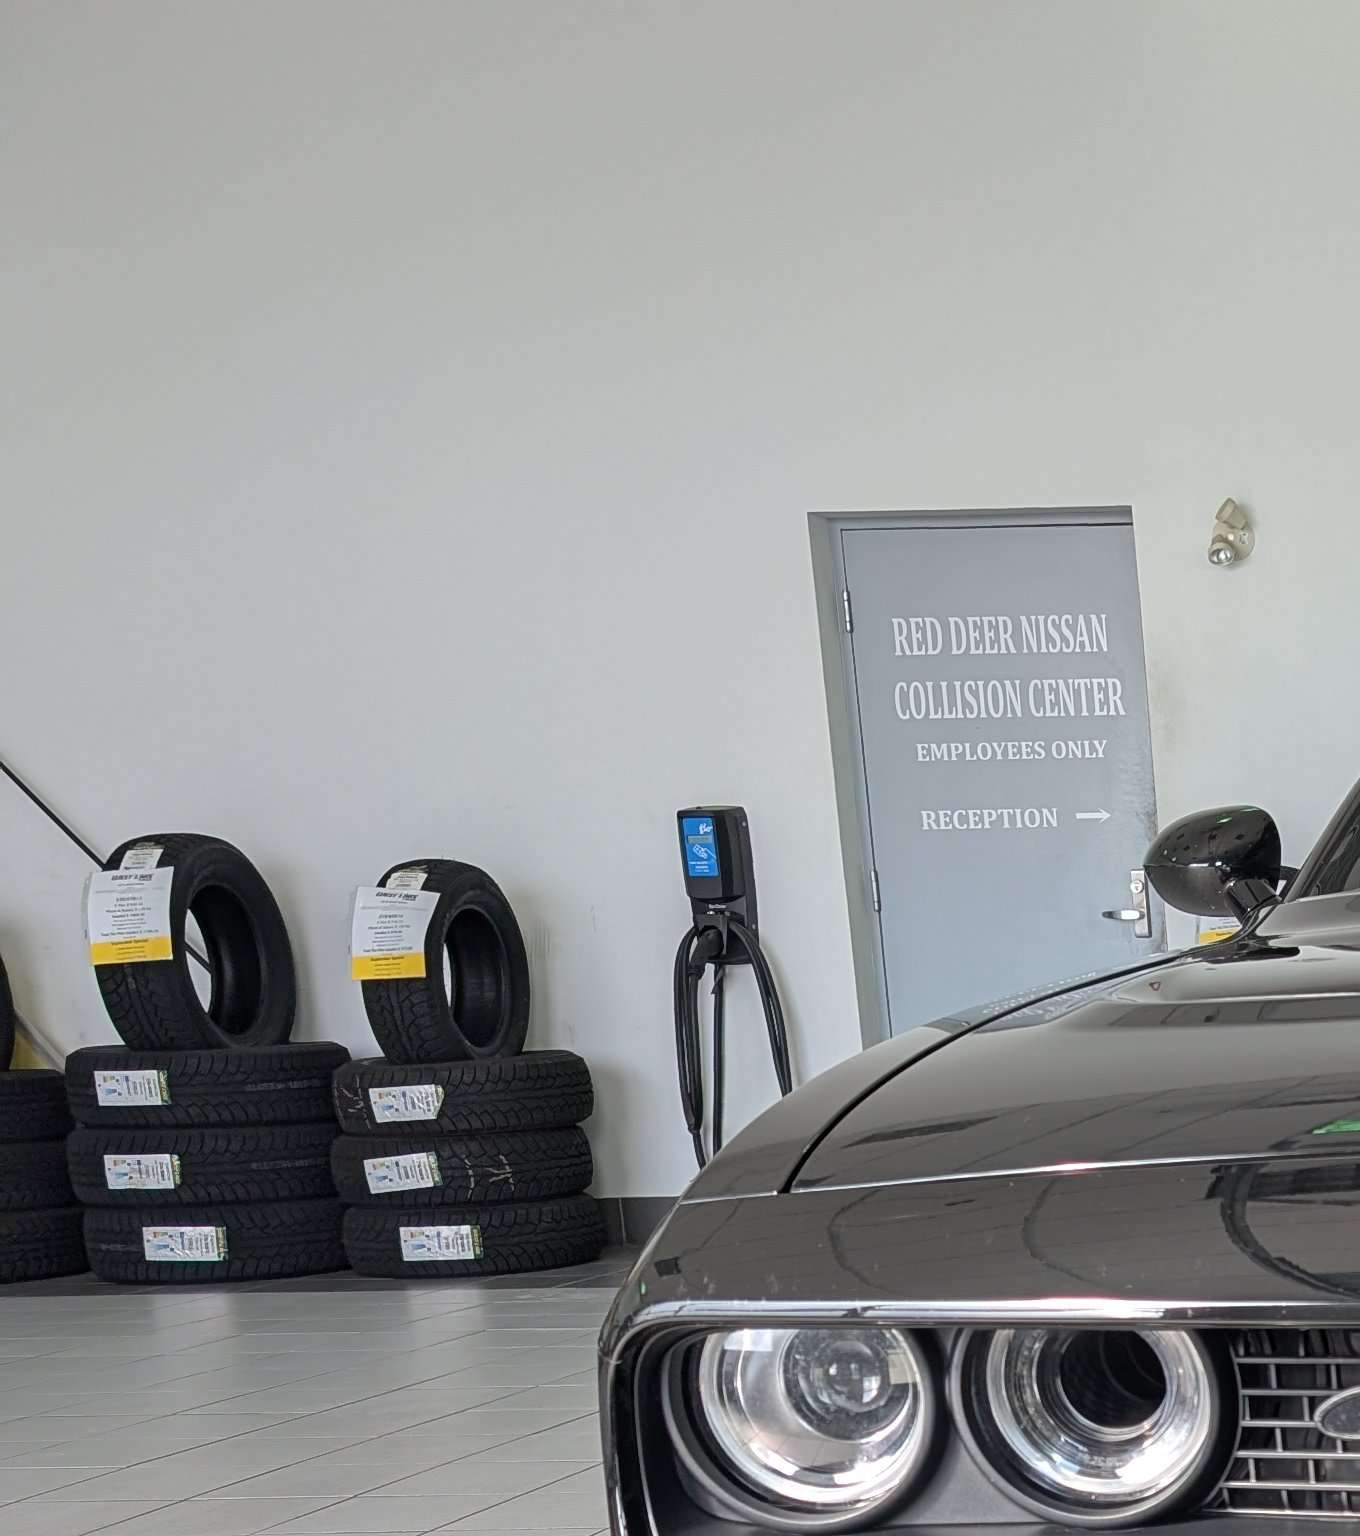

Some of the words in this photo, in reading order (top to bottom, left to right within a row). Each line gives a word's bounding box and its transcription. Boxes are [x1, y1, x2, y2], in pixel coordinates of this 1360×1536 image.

[891, 616, 943, 656] RED
[949, 616, 1017, 656] DEER
[1021, 614, 1109, 655] NISSAN
[894, 680, 1022, 720] COLLISION
[1028, 678, 1127, 718] CENTER
[916, 741, 1047, 763] EMPLOYEES
[1051, 739, 1108, 760] ONLY
[920, 808, 1059, 831] RECEPTION
